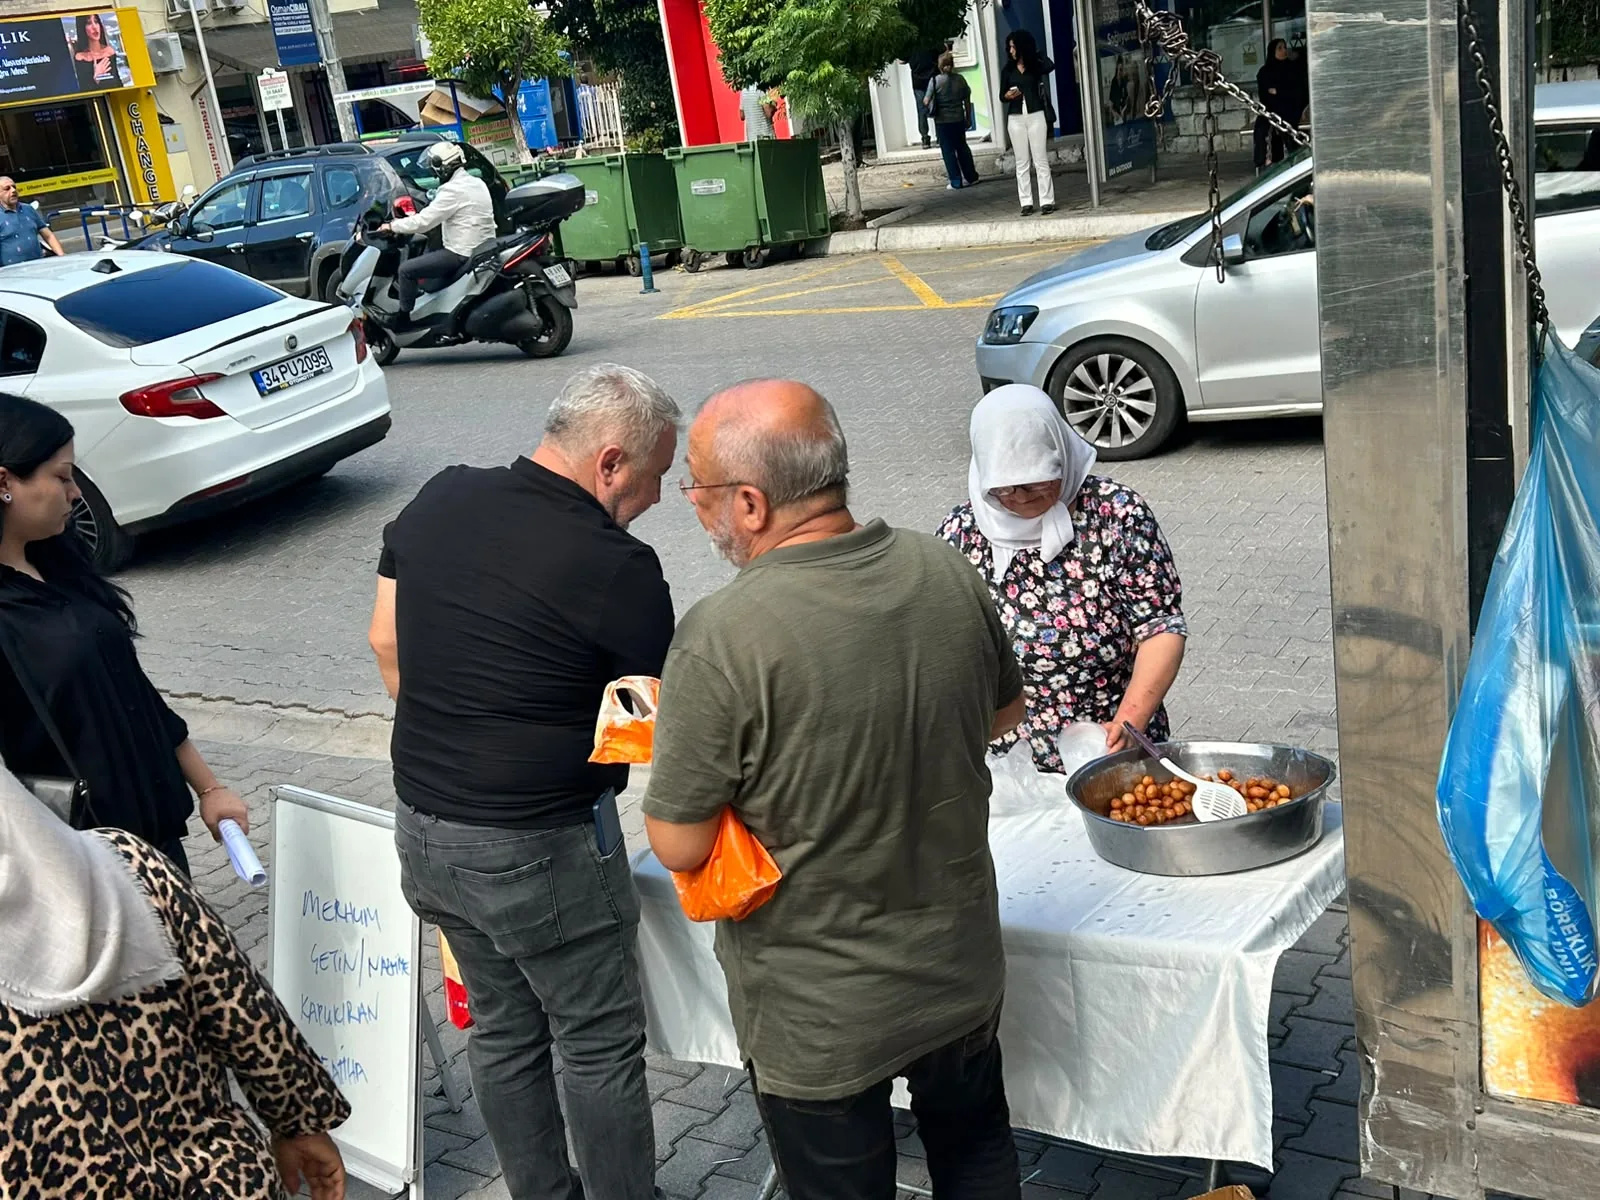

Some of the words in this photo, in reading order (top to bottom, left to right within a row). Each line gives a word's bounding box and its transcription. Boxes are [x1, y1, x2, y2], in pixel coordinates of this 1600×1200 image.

[127, 102, 160, 200] CHANGE
[302, 889, 381, 932] MERHUM
[1545, 887, 1597, 975] BÖREKLİK
